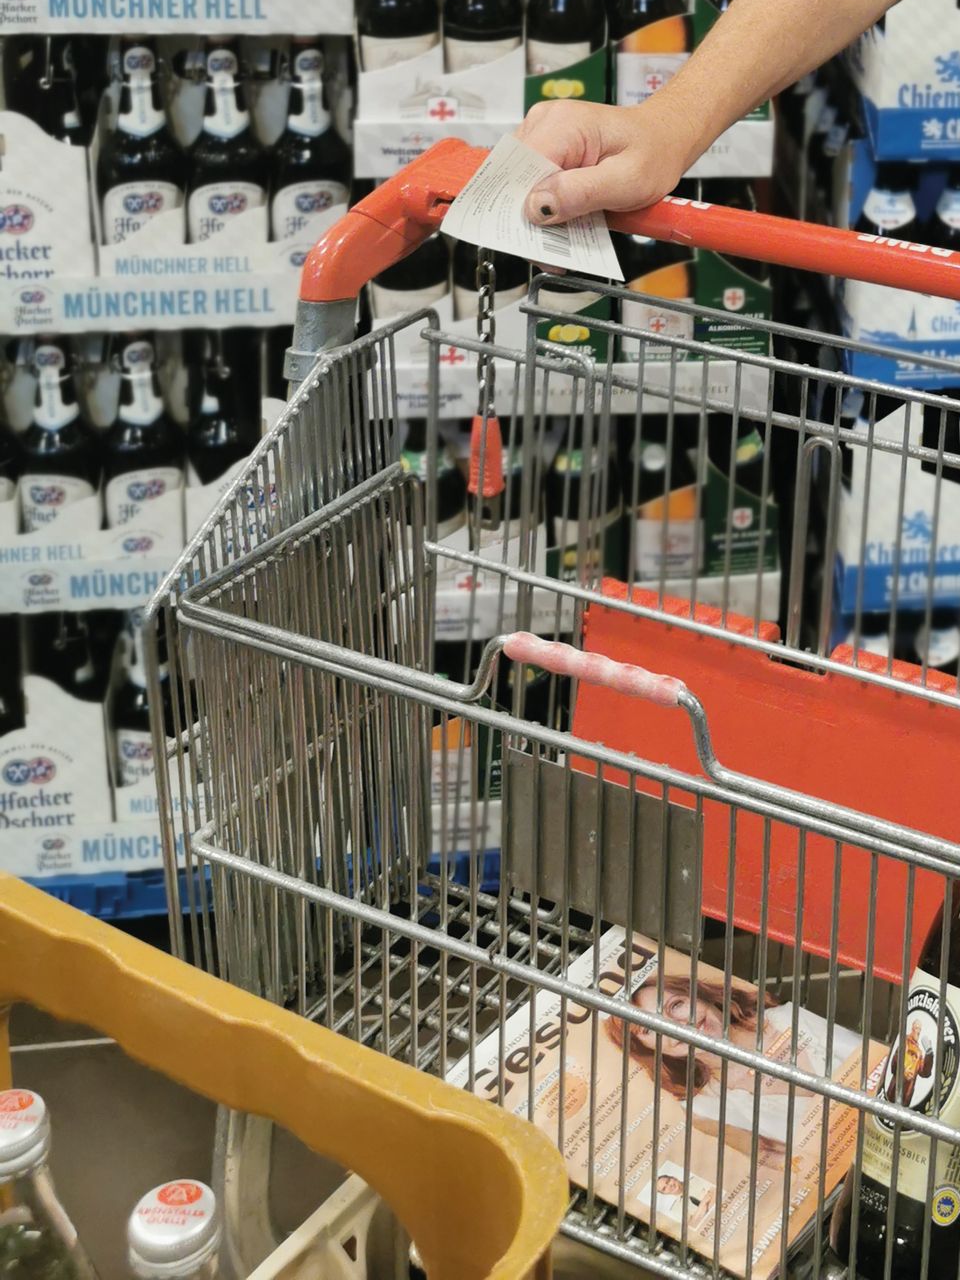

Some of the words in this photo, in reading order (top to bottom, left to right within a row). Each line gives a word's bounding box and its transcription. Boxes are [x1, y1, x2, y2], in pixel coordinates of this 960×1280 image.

[115, 256, 207, 276] MÜNCHNER
[213, 256, 253, 273] HELL
[64, 288, 208, 319] MÜNCHNER
[215, 288, 275, 314] HELL
[50, 543, 85, 560] HELL
